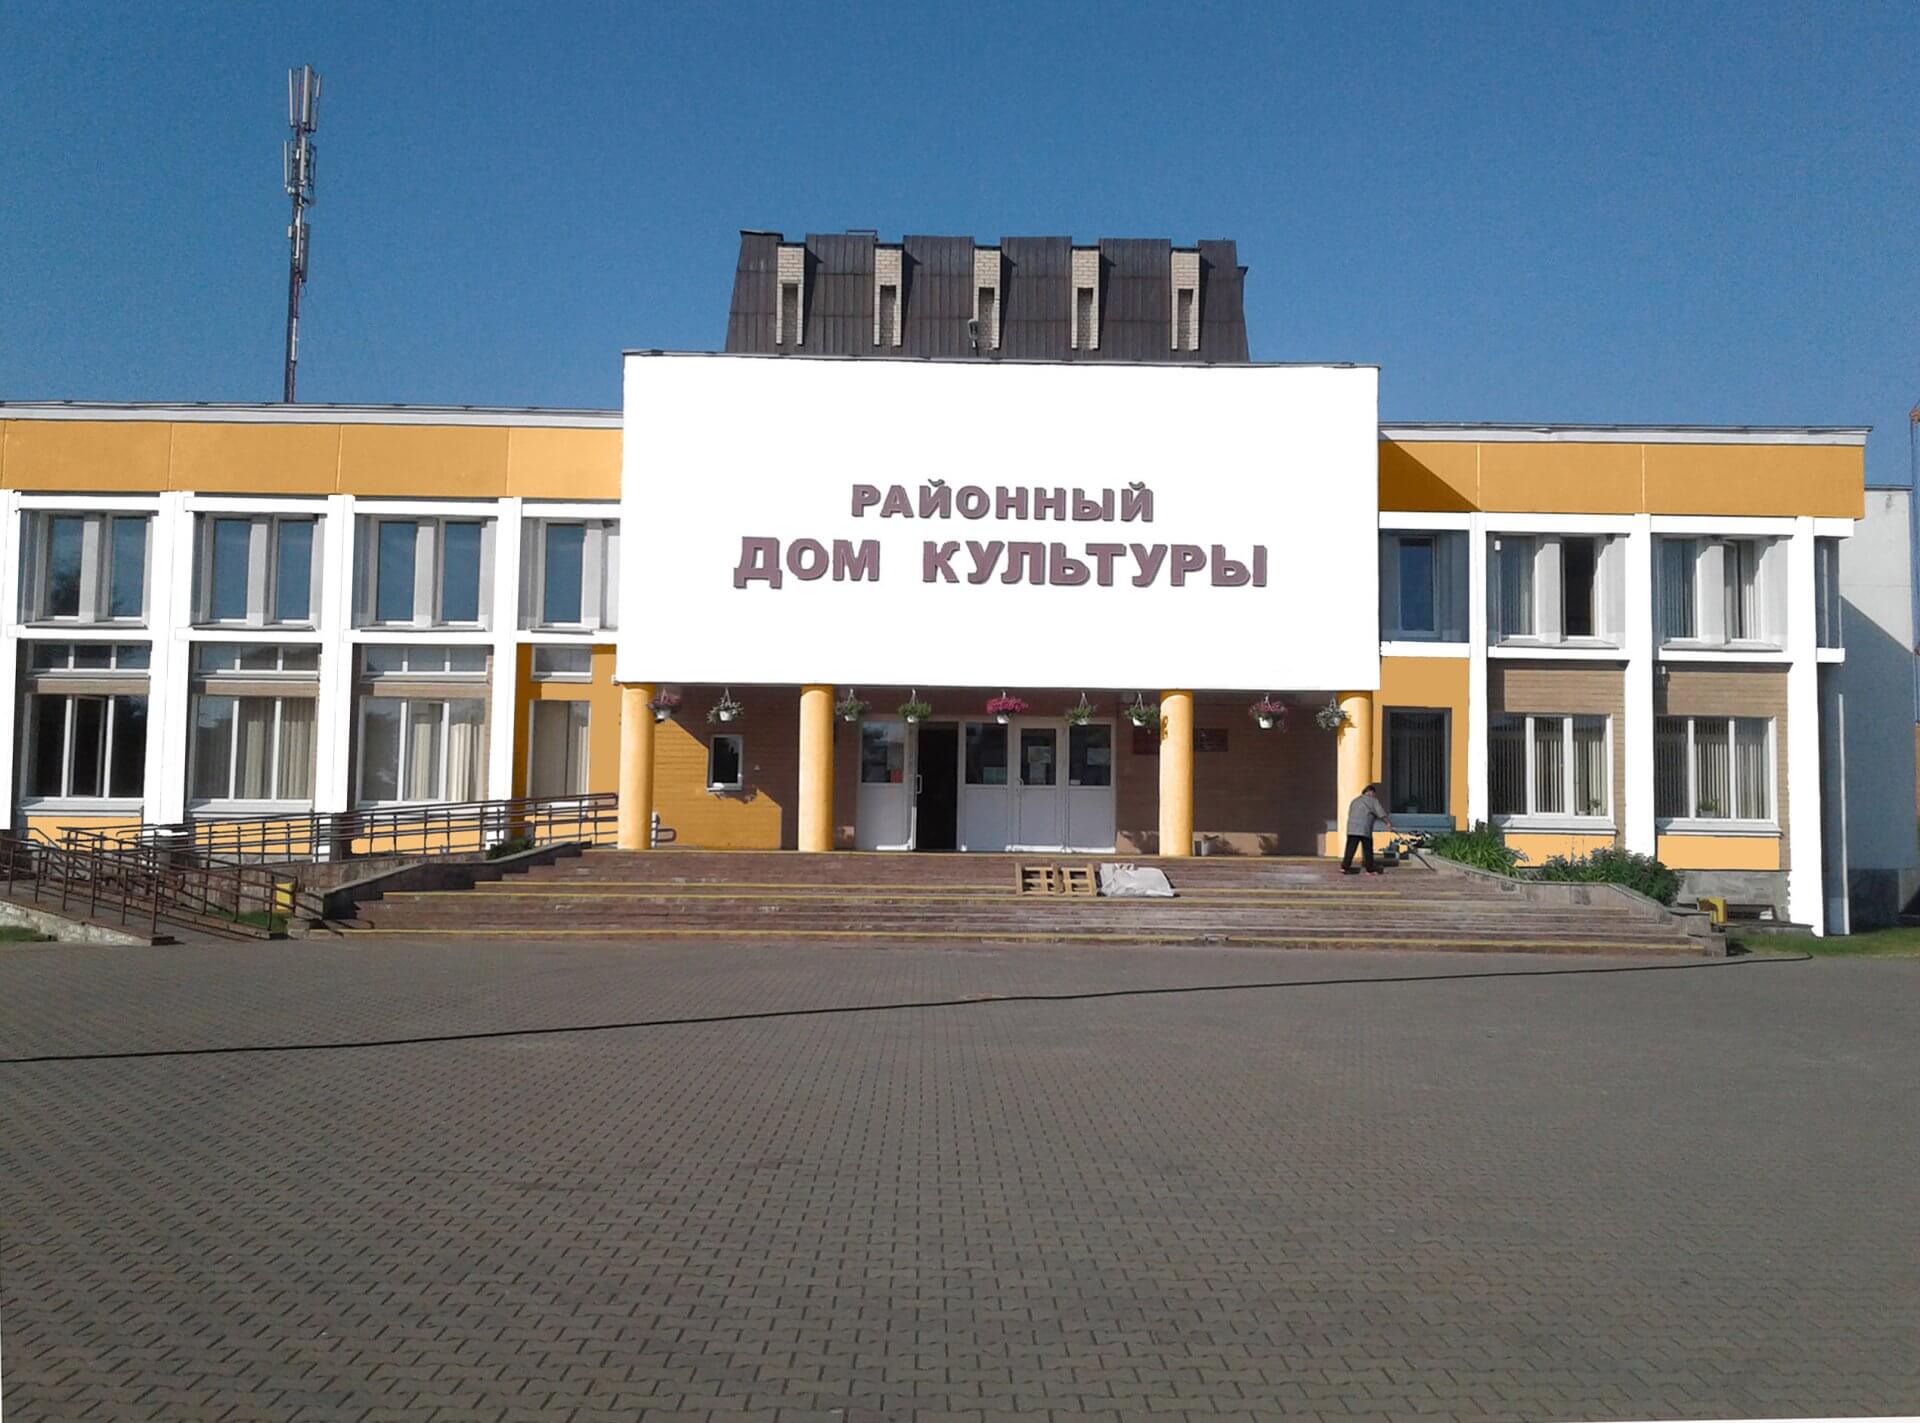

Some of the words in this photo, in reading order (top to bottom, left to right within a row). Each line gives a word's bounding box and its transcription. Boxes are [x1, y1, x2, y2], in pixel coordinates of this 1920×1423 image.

[852, 479, 1153, 522] РАЙОННЫЙ
[733, 536, 880, 590] ДОМ
[923, 541, 1267, 588] КУЛЬТУРЫ
